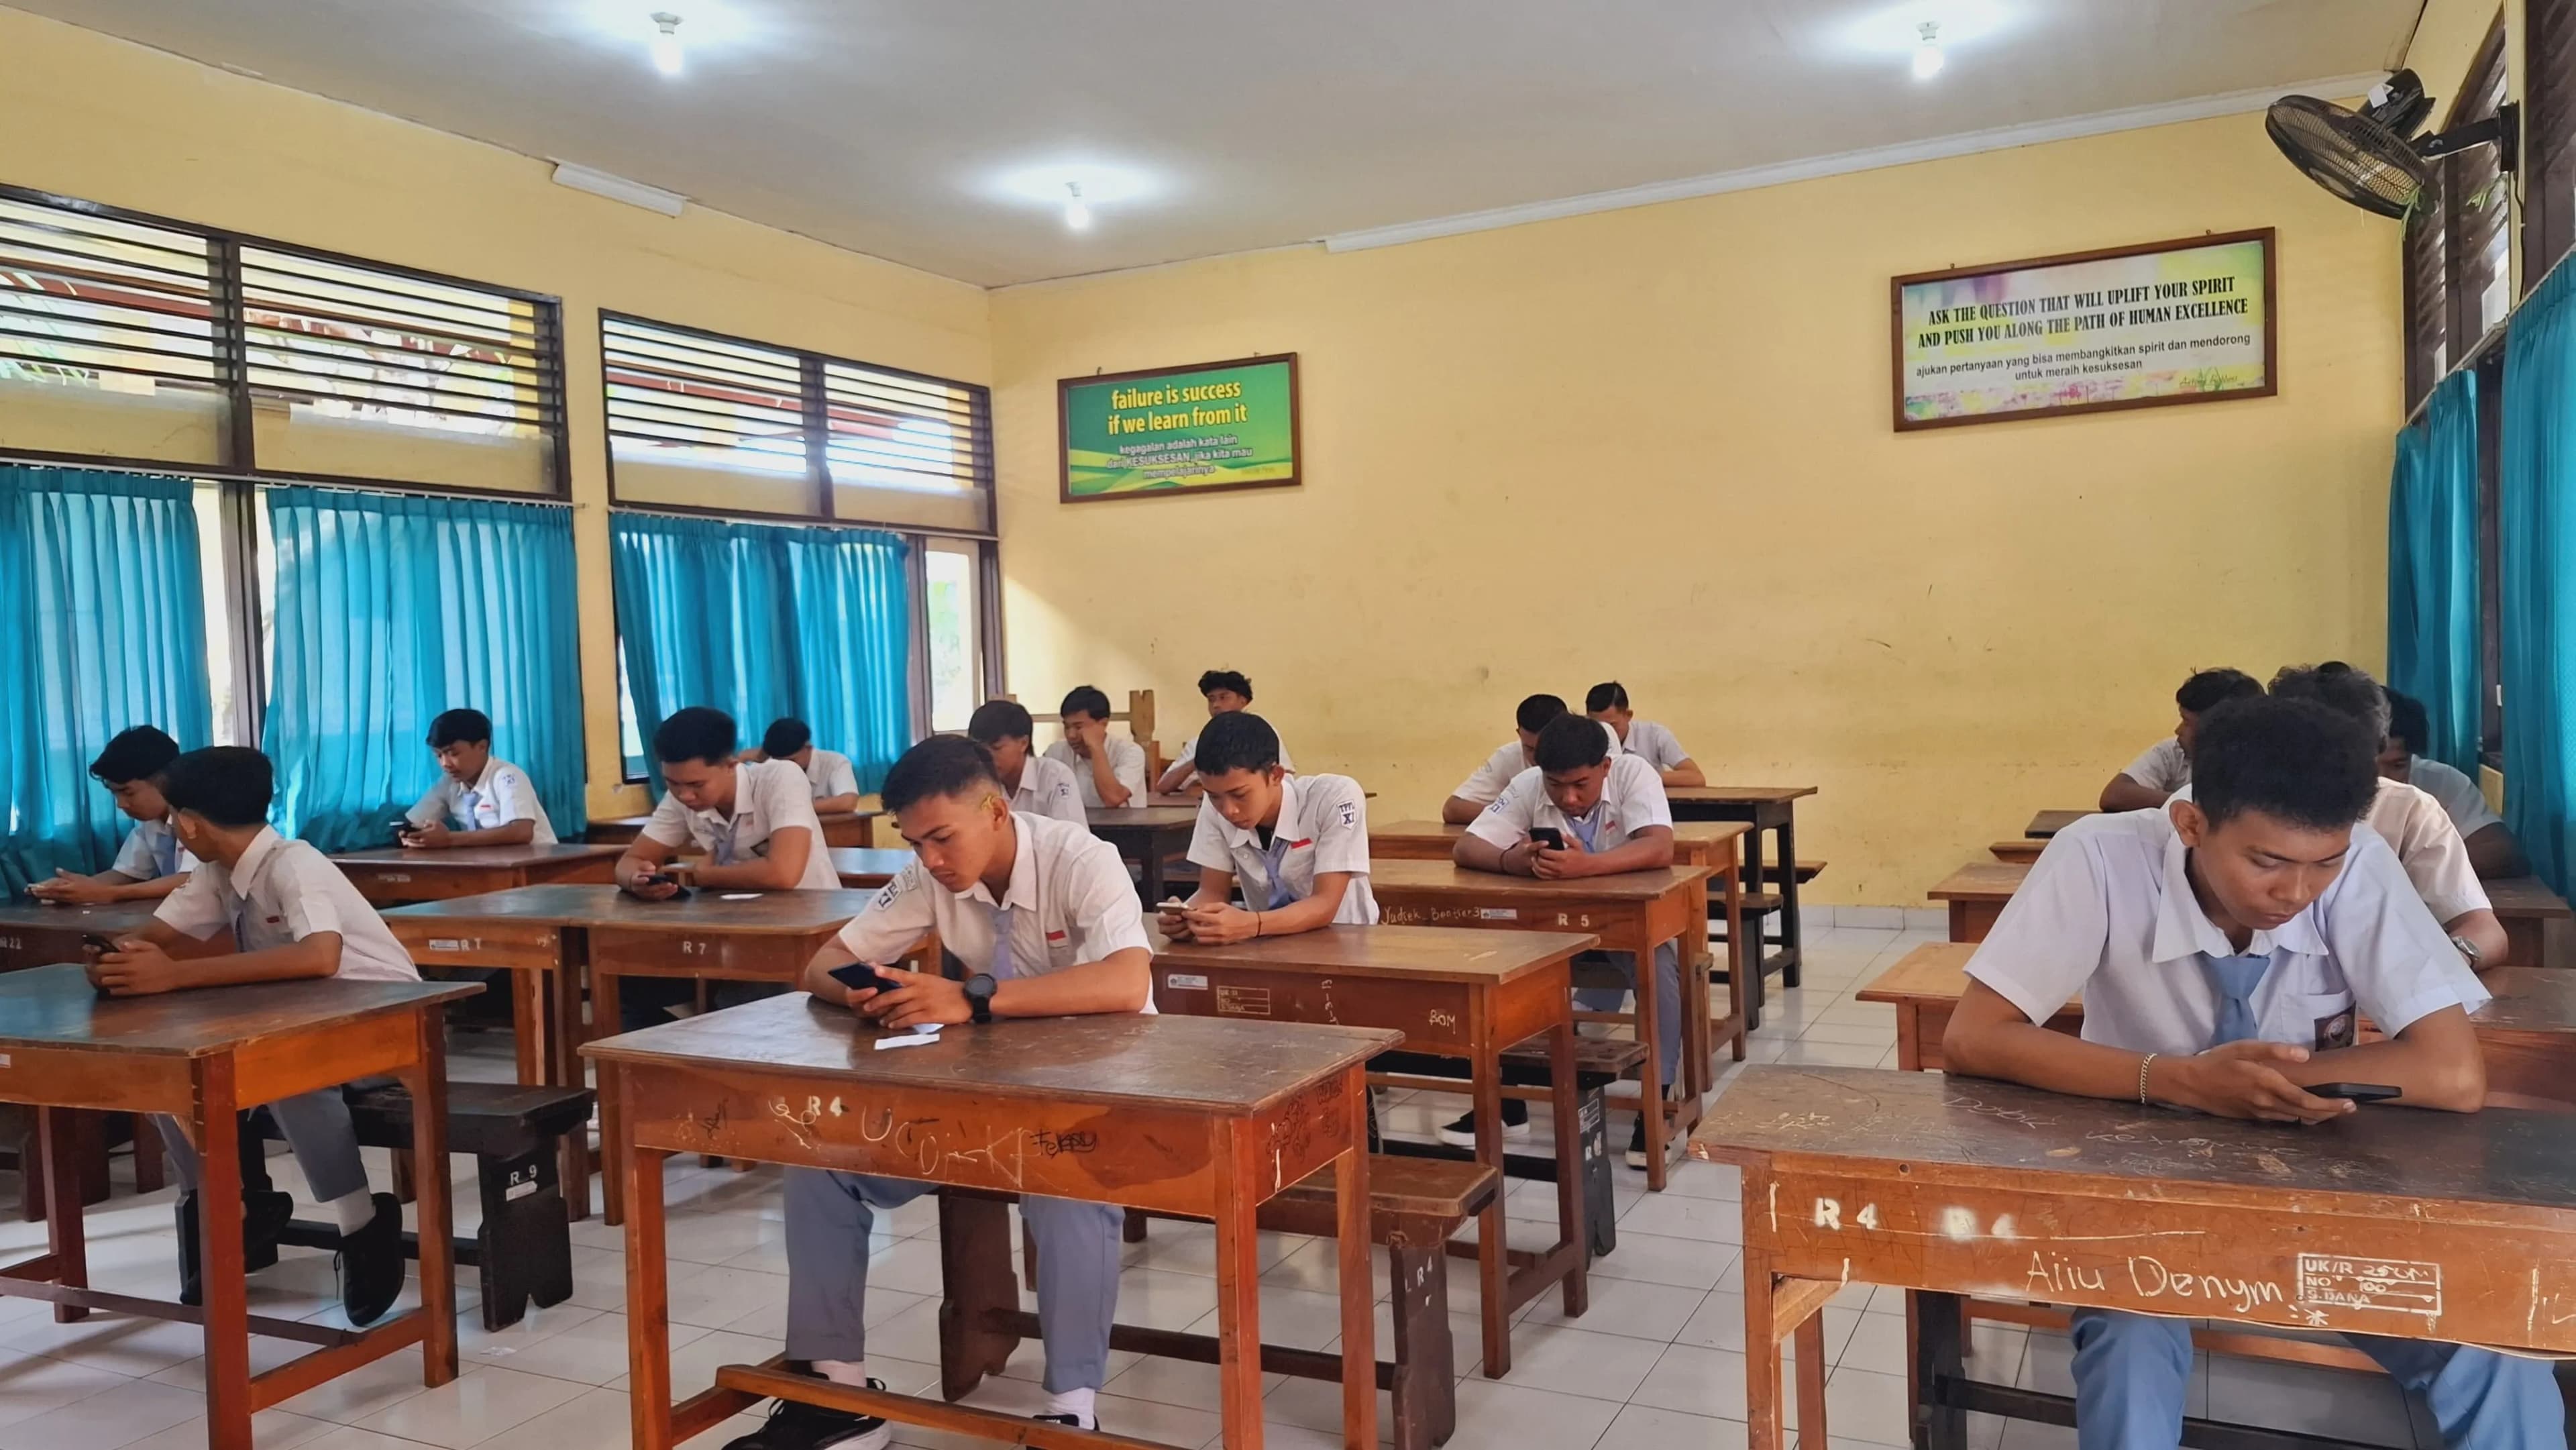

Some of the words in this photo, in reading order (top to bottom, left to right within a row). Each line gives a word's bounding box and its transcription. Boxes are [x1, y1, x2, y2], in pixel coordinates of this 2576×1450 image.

[1929, 309, 1949, 325] ASK
[1953, 306, 1976, 323] THE
[1980, 299, 2035, 320] QUESTION
[2039, 295, 2071, 313] THAT
[2074, 289, 2104, 308] WILL
[2108, 286, 2150, 305] UPLIFT
[2154, 281, 2188, 300] YOUR
[2192, 276, 2235, 296] SPIRIT
[1918, 332, 1940, 348] AND
[1945, 328, 1974, 346] PUSH
[1978, 325, 2000, 342] YOU
[2004, 321, 2043, 338] ALONG
[2047, 316, 2070, 334] THE
[2075, 313, 2105, 331] PATH
[2109, 311, 2125, 327] OF
[2129, 306, 2171, 325] HUMAN
[2176, 298, 2248, 321] EXCELLENCE
[1916, 364, 1947, 378] ajukan
[1950, 358, 2003, 375] pertanyaan
[2006, 356, 2030, 368] yang
[2033, 354, 2053, 364] bisa
[2056, 346, 2136, 362] membangkitkan
[2139, 341, 2165, 355] spirit
[2168, 339, 2187, 351] dan
[2190, 334, 2251, 349] mendorong
[2015, 368, 2043, 380] untuk
[2045, 364, 2080, 377] meraih
[2082, 359, 2142, 374] kesuksesan
[1112, 387, 1163, 410] failure
[1166, 384, 1179, 404] is
[1182, 381, 1241, 403] success
[1108, 414, 1120, 435] if
[1122, 417, 1145, 433] we
[1148, 411, 1189, 431] learn
[1192, 406, 1231, 427] from
[1234, 403, 1247, 422] it
[1120, 441, 1165, 455] kegagalan
[1167, 438, 1197, 451] adalah
[1198, 437, 1219, 448] kata
[1220, 435, 1238, 446] lain
[1212, 450, 1230, 460] kita
[1232, 448, 1253, 458] mau
[1558, 913, 1568, 926] R
[1580, 915, 1589, 927] 5
[461, 939, 470, 951] R
[683, 941, 692, 953] R
[698, 943, 706, 955] 7
[808, 1096, 821, 1117] R
[830, 1096, 843, 1117] 4
[1585, 1145, 1593, 1161] R
[511, 1171, 519, 1186] R
[529, 1164, 537, 1178] 9
[1815, 1197, 1841, 1230] R
[1856, 1202, 1877, 1230] 4
[1417, 1267, 1424, 1287] R
